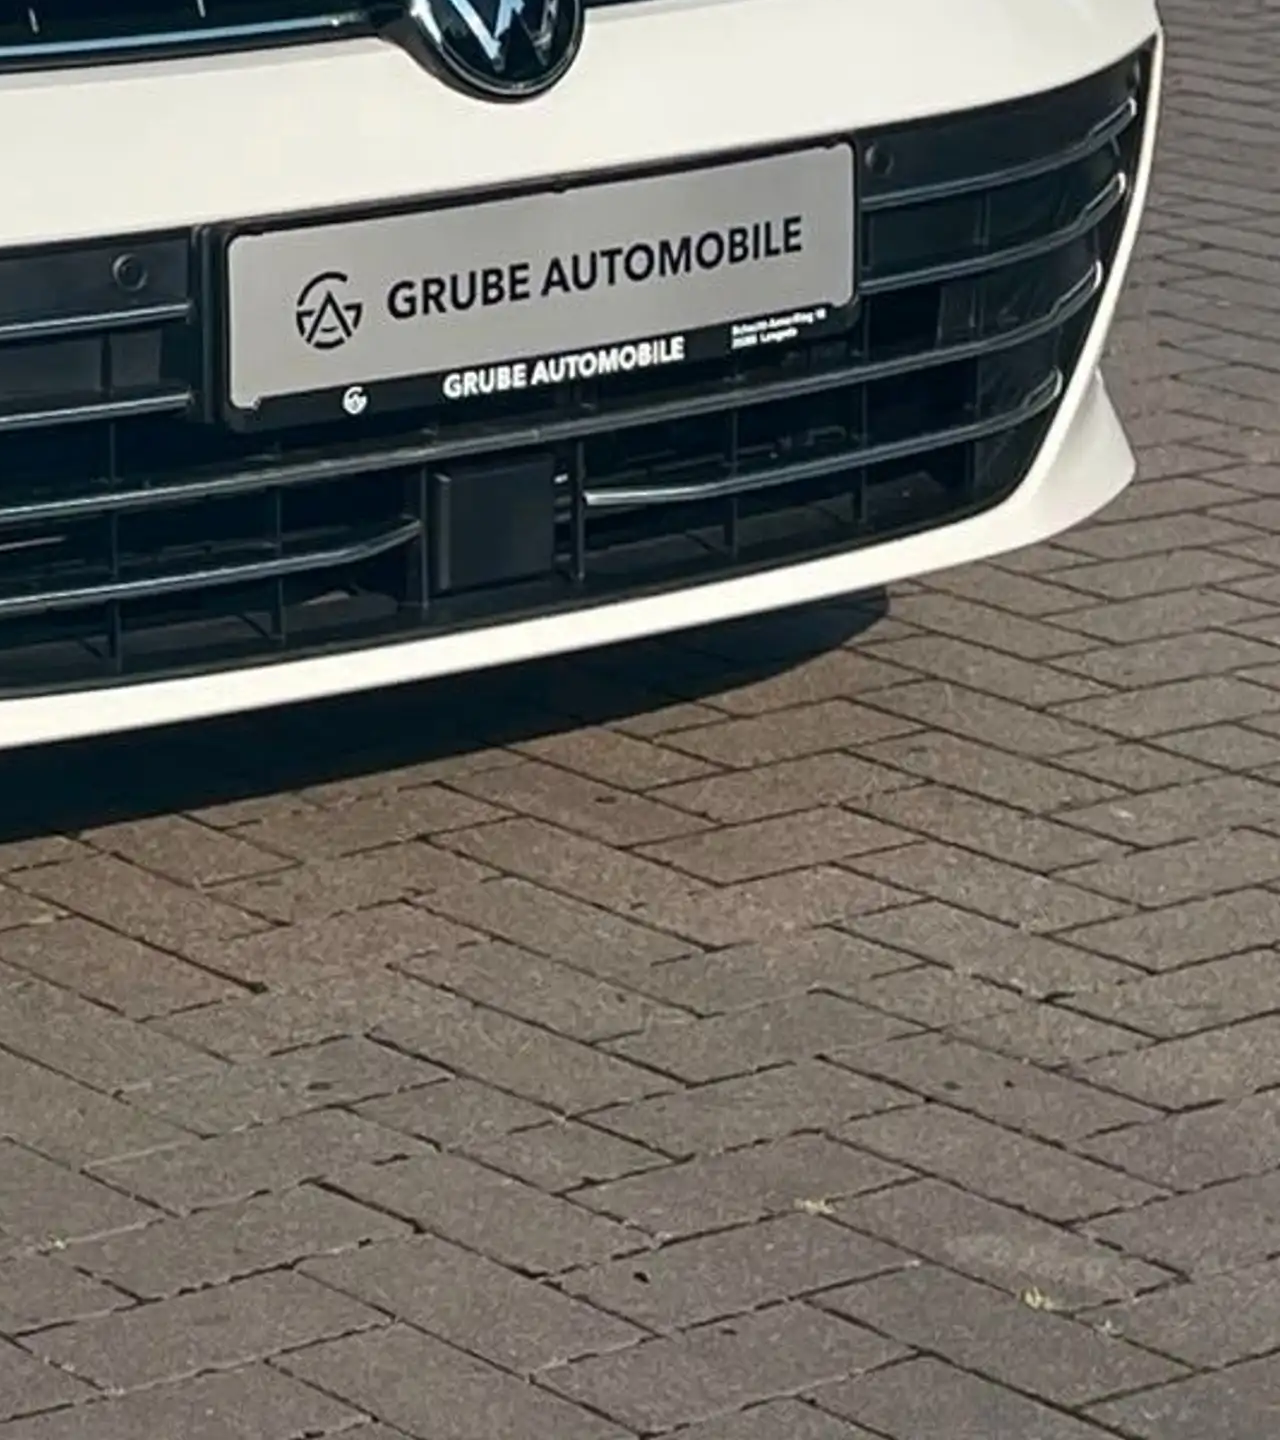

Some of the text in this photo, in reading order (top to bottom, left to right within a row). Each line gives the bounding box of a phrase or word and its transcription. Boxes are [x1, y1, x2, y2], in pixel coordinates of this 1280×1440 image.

[388, 216, 801, 318] GRUBE AUTOMOBILE
[442, 366, 527, 399] GRUBE
[531, 336, 685, 386] AUTOMOBILE
